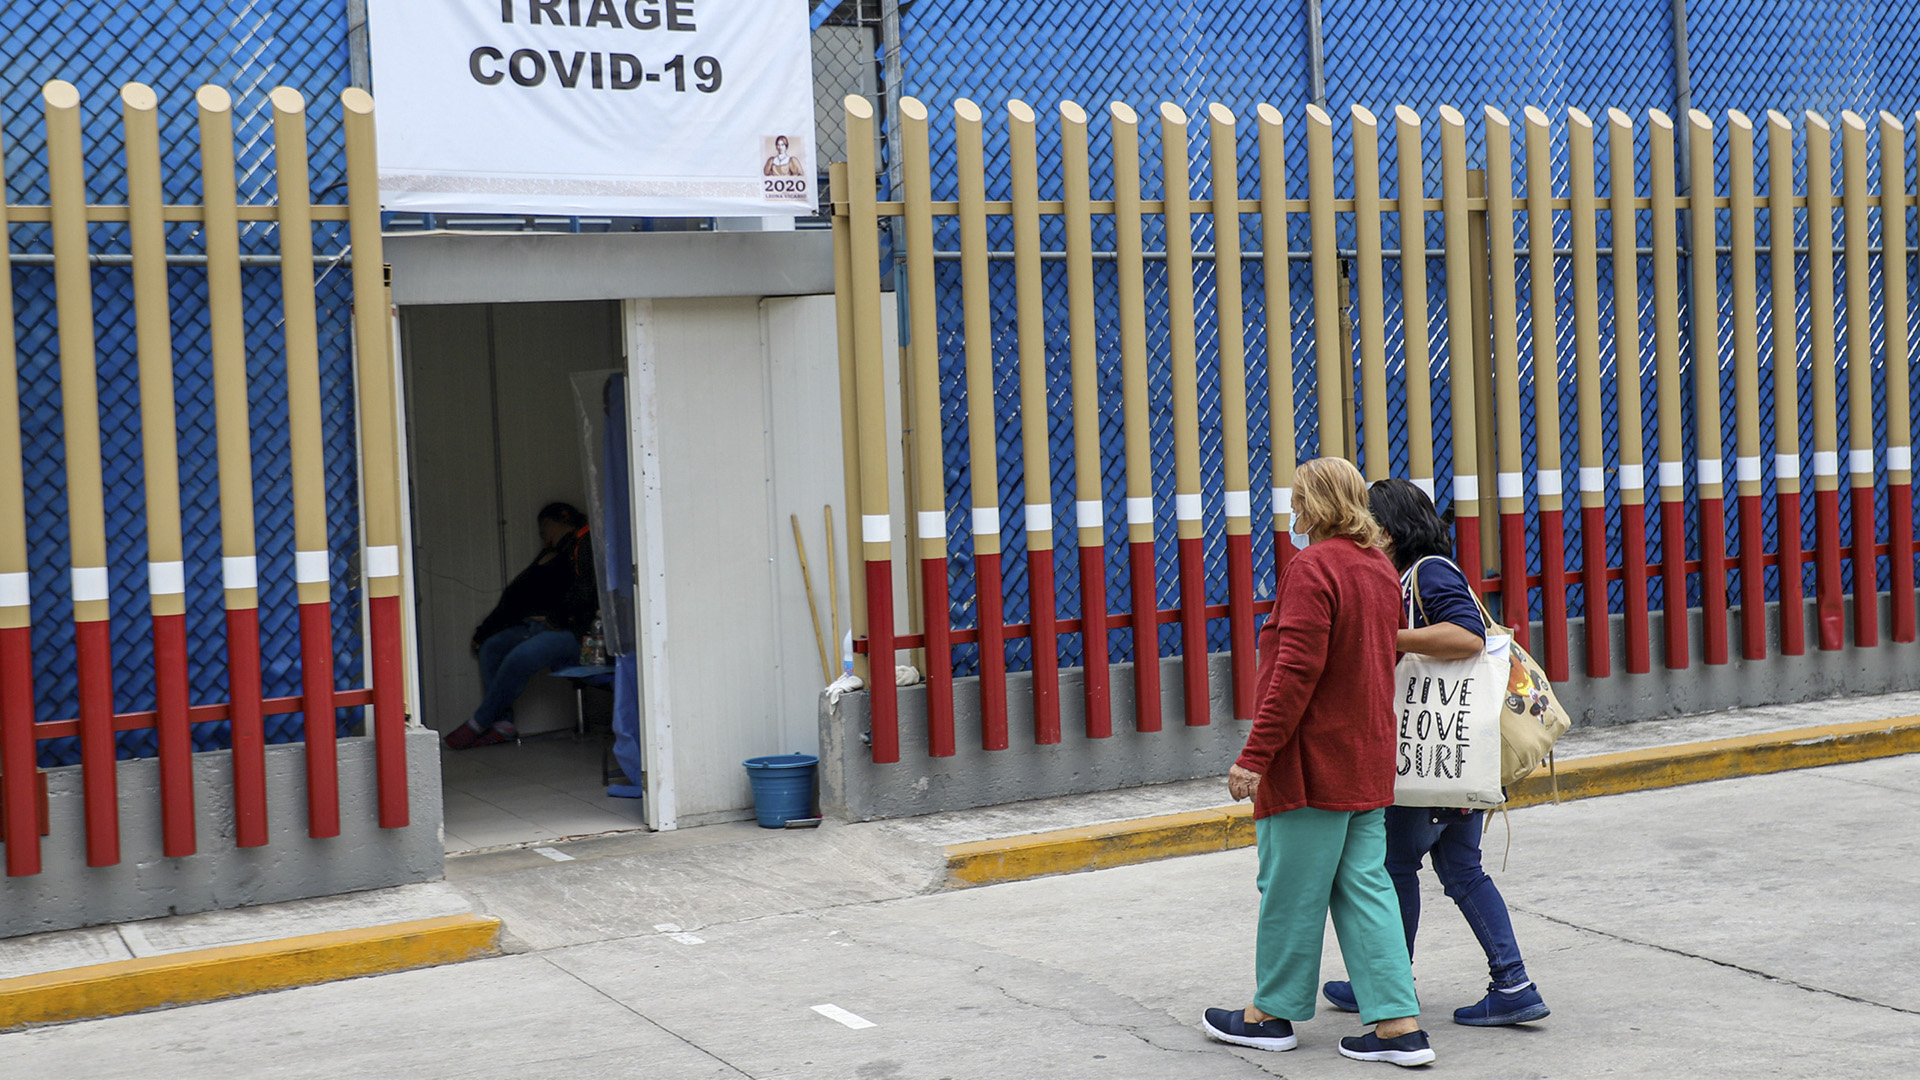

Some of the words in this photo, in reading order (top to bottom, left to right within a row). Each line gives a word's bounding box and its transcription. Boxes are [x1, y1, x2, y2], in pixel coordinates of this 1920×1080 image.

[469, 46, 722, 93] COVID-19
[764, 180, 806, 192] 2020
[1406, 676, 1475, 706] LIVE
[1400, 709, 1471, 741] LOVE
[1397, 742, 1470, 779] SURF
